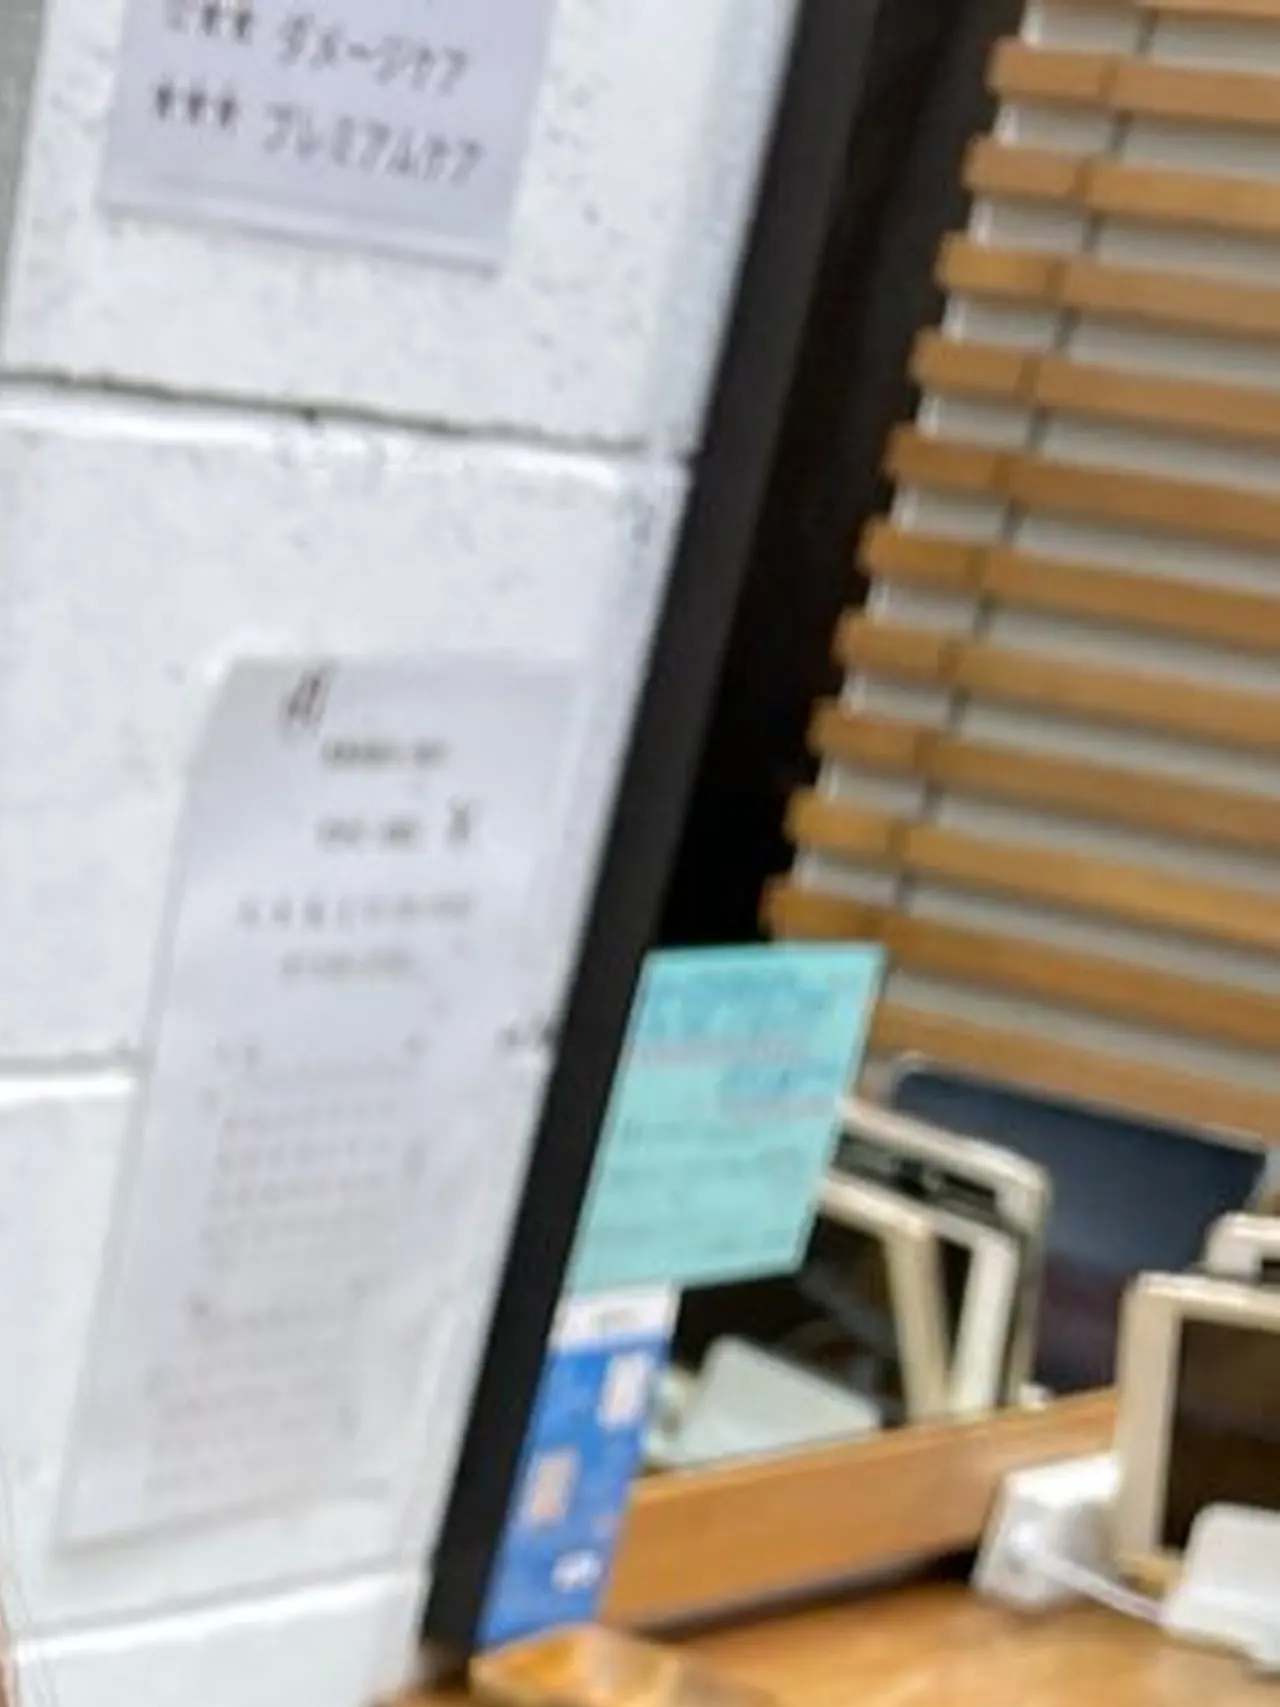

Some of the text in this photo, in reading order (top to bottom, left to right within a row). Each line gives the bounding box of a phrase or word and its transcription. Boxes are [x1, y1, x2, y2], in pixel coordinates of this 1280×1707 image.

[261, 102, 484, 186] プレミアムケア
